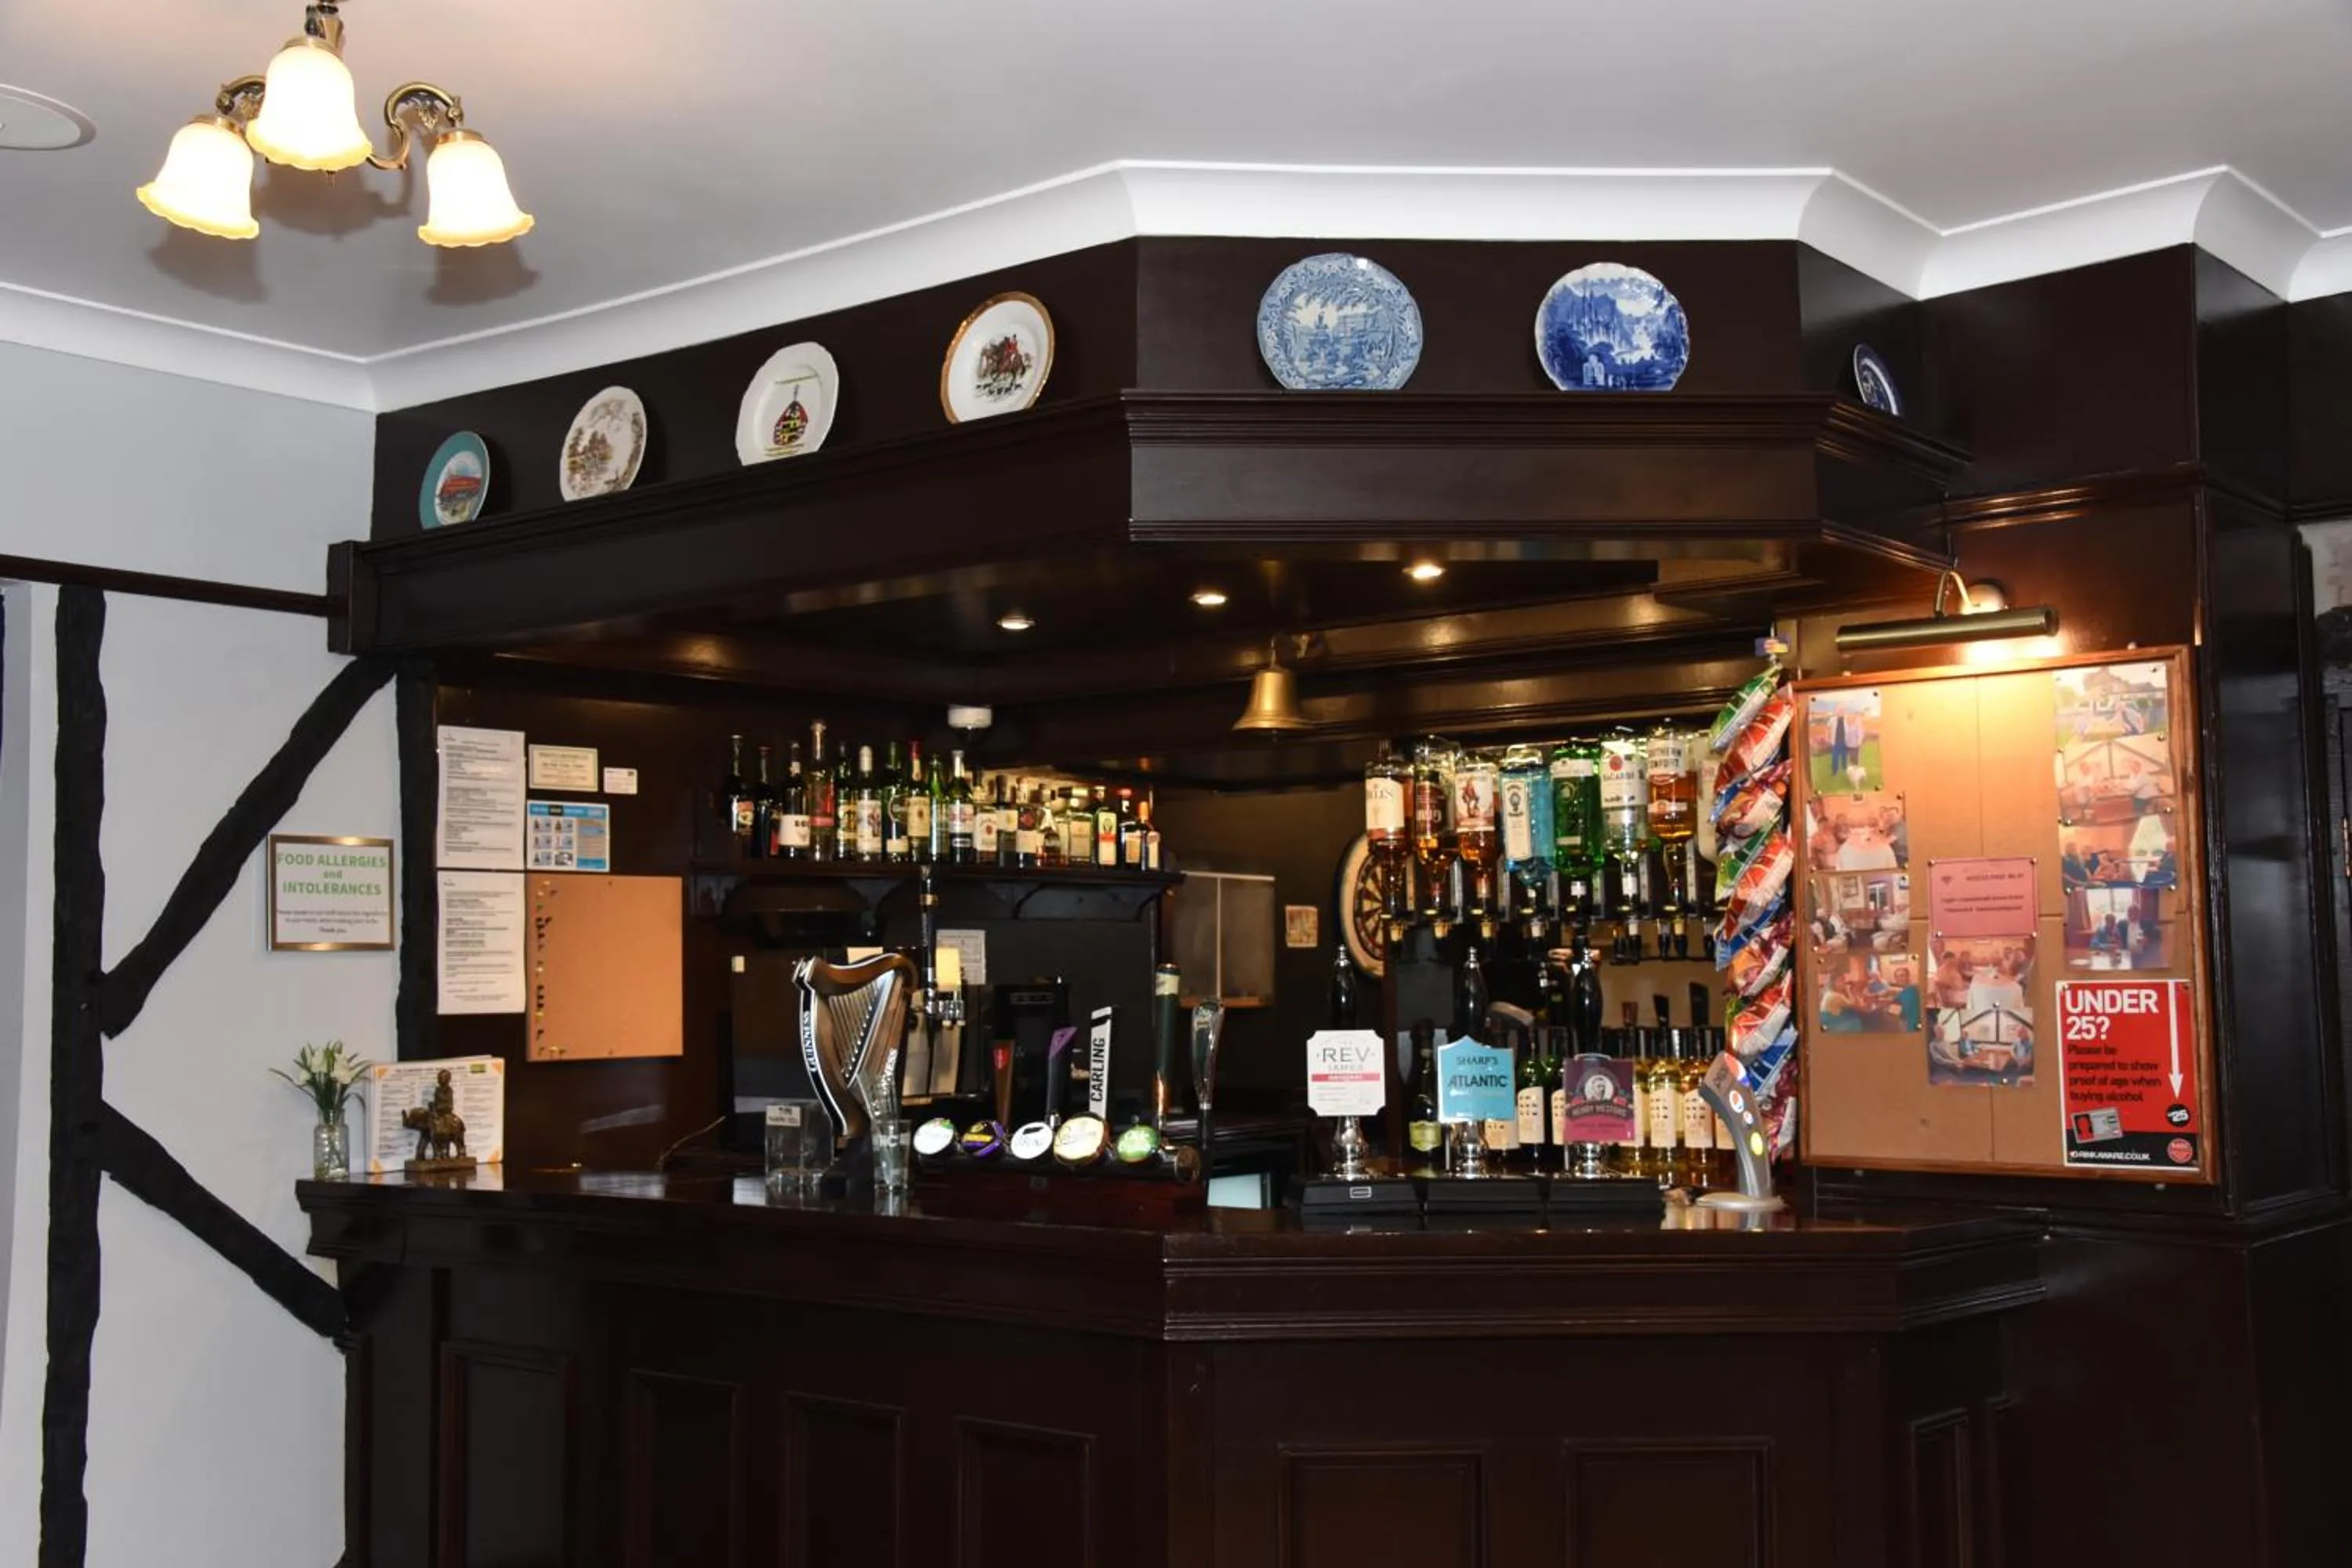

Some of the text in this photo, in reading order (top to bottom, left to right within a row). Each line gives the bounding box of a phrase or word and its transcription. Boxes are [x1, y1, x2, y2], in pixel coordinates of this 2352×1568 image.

[276, 853, 386, 868] FOOD ALLERGIES
[323, 870, 343, 879] and
[283, 881, 382, 895] INTOLERANCES
[2065, 989, 2159, 1014] UNDER
[2066, 1015, 2111, 1040] 25?
[803, 1010, 818, 1073] GUINNESS
[1322, 1047, 1370, 1062] REV
[2067, 1044, 2102, 1054] Please
[1091, 1037, 1105, 1102] CARLING
[2068, 1062, 2158, 1073] prepared to show
[1448, 1075, 1508, 1087] ATLANTIC
[2069, 1076, 2161, 1088] proof of age when
[2070, 1091, 2103, 1102] buying
